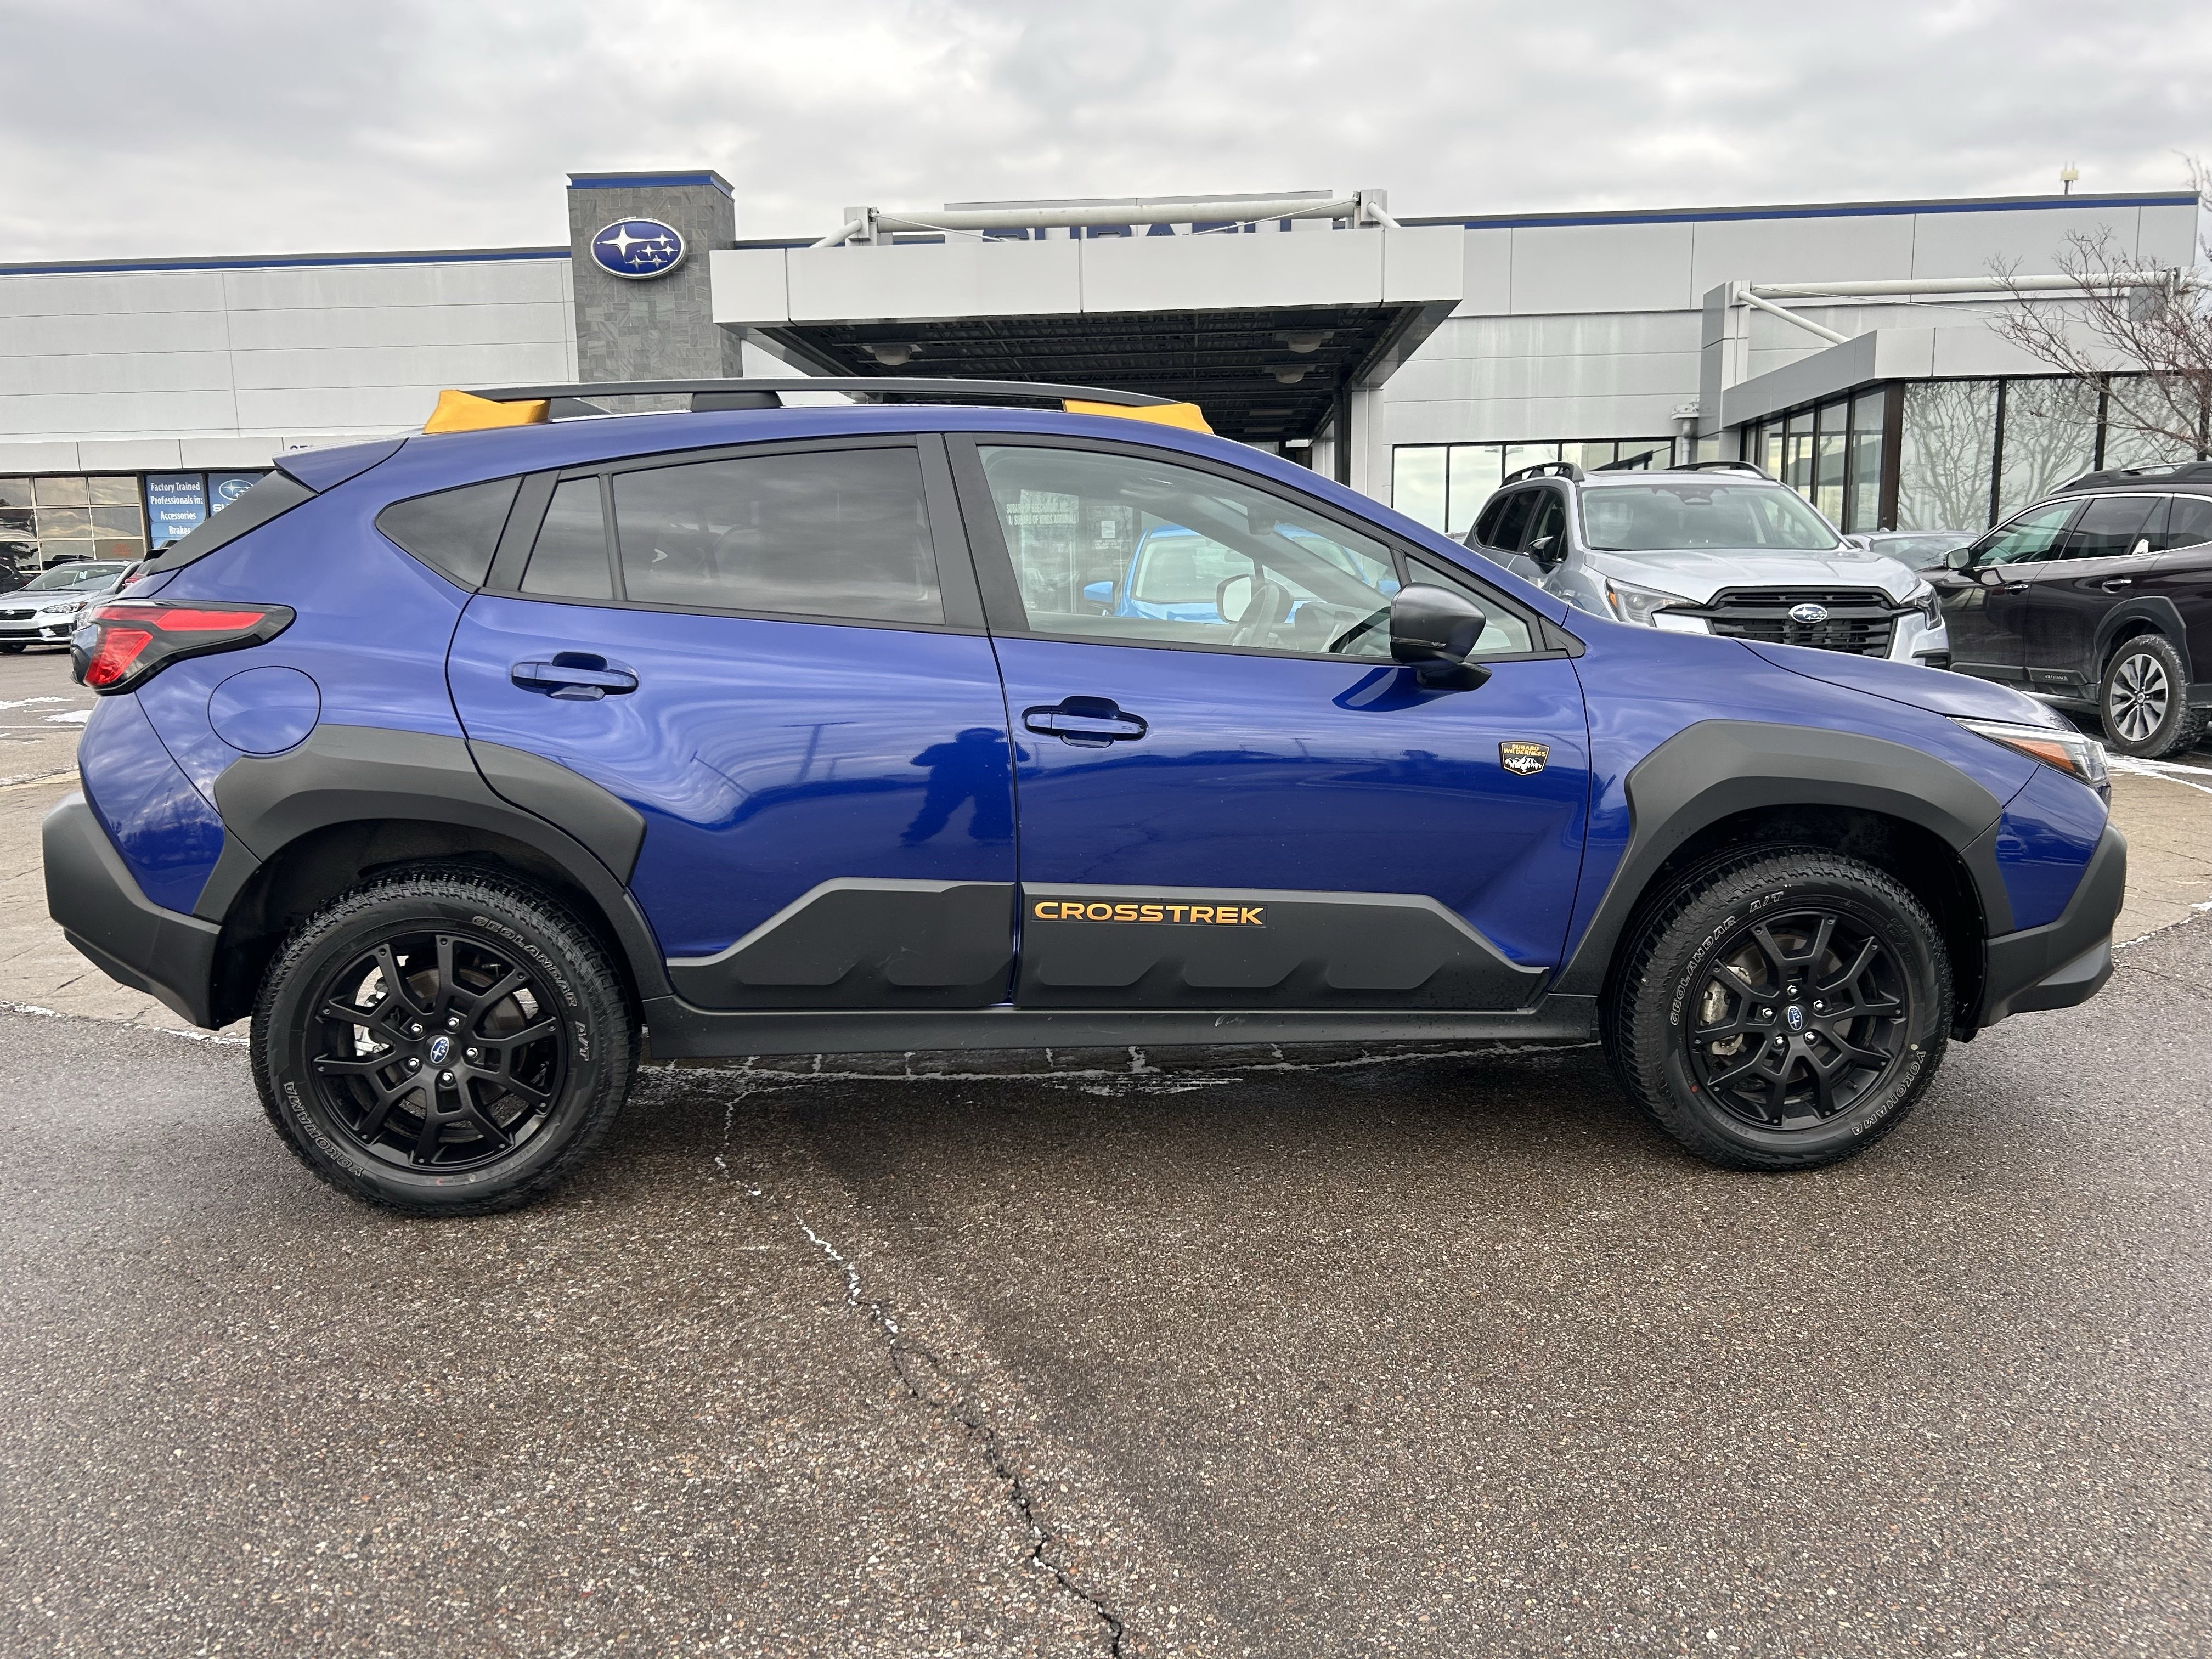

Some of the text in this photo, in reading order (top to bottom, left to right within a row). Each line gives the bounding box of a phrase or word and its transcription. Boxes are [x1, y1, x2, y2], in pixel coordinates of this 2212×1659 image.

[150, 482, 200, 493] Factory Trained
[150, 495, 204, 505] Professionals in:
[160, 511, 196, 520] Accessories
[168, 526, 191, 535] Brakes
[1503, 748, 1546, 757] WILDERNESS
[1034, 902, 1264, 925] CROSSTREK
[1670, 891, 1784, 1026] GEOLANDAR A/T
[472, 916, 590, 1062] GEOLANDAR A/T
[1852, 1051, 1926, 1136] YOKOHAMA
[284, 1081, 364, 1177] YOKOHAMA
